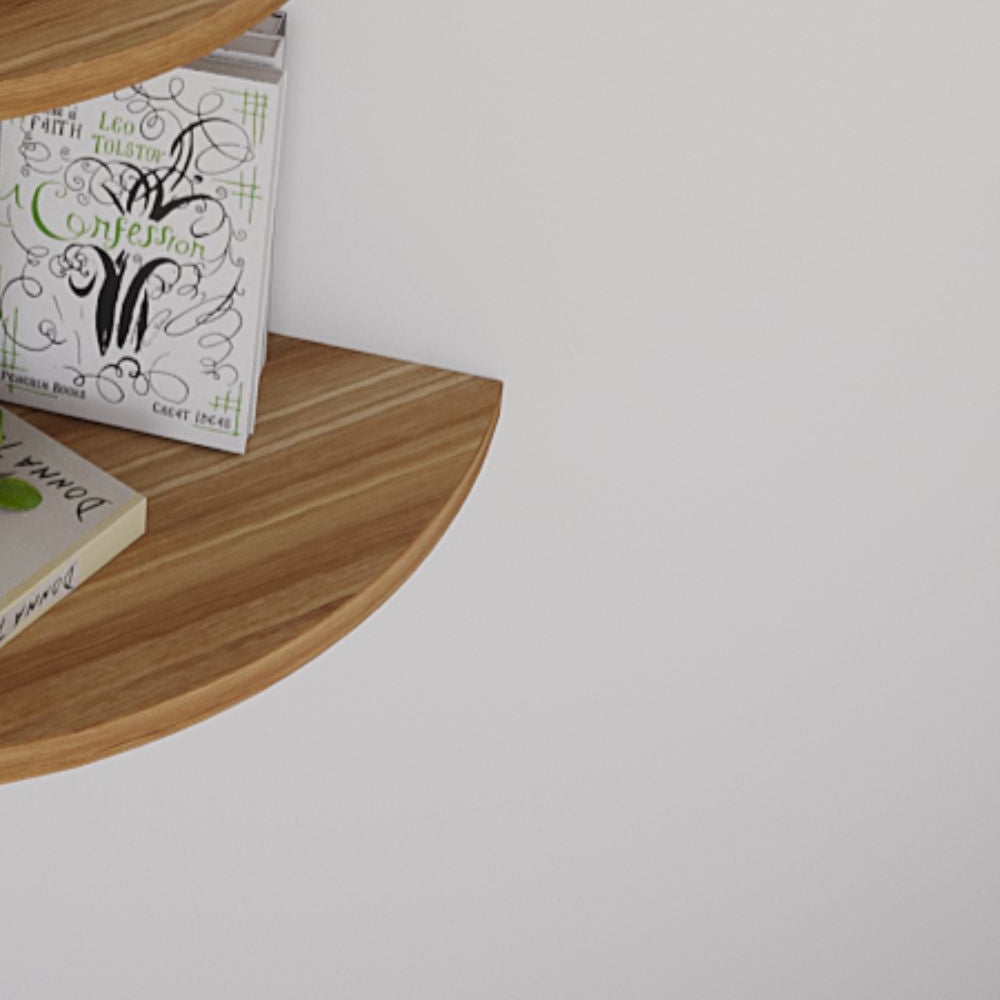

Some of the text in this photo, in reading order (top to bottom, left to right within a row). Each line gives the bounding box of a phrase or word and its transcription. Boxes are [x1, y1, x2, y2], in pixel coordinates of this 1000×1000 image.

[30, 114, 83, 140] FAITH
[31, 181, 206, 260] Confession
[14, 455, 112, 523] DONNA
[15, 564, 75, 628] DONNA
